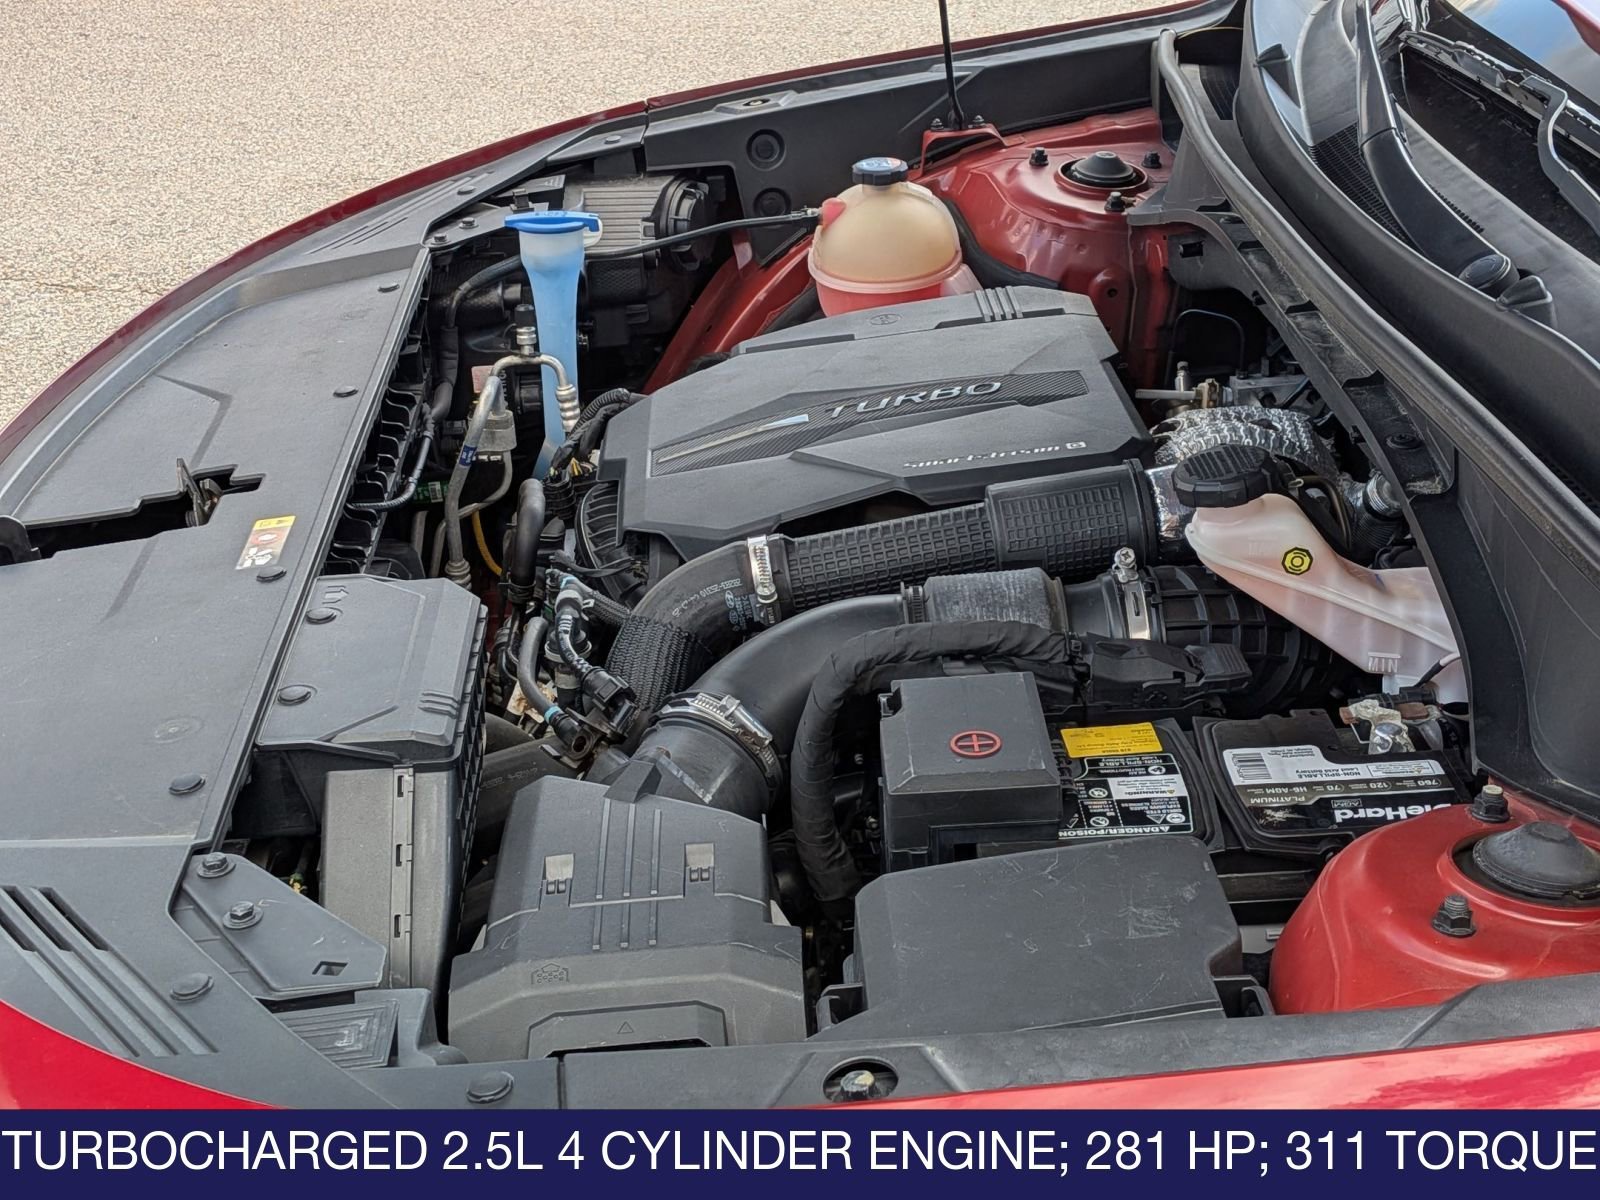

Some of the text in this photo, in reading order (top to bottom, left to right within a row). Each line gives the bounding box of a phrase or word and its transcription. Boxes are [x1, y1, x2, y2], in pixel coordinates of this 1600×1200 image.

[824, 382, 1002, 419] TURBO
[1368, 656, 1398, 673] MIN
[1297, 771, 1361, 779] NON-SPILLABLE
[1417, 778, 1439, 786] 760
[1265, 786, 1308, 794] H6-AGM
[1250, 796, 1306, 804] PLATINUM
[1333, 803, 1452, 823] ieHard
[1058, 826, 1160, 837] DANGER/POISON
